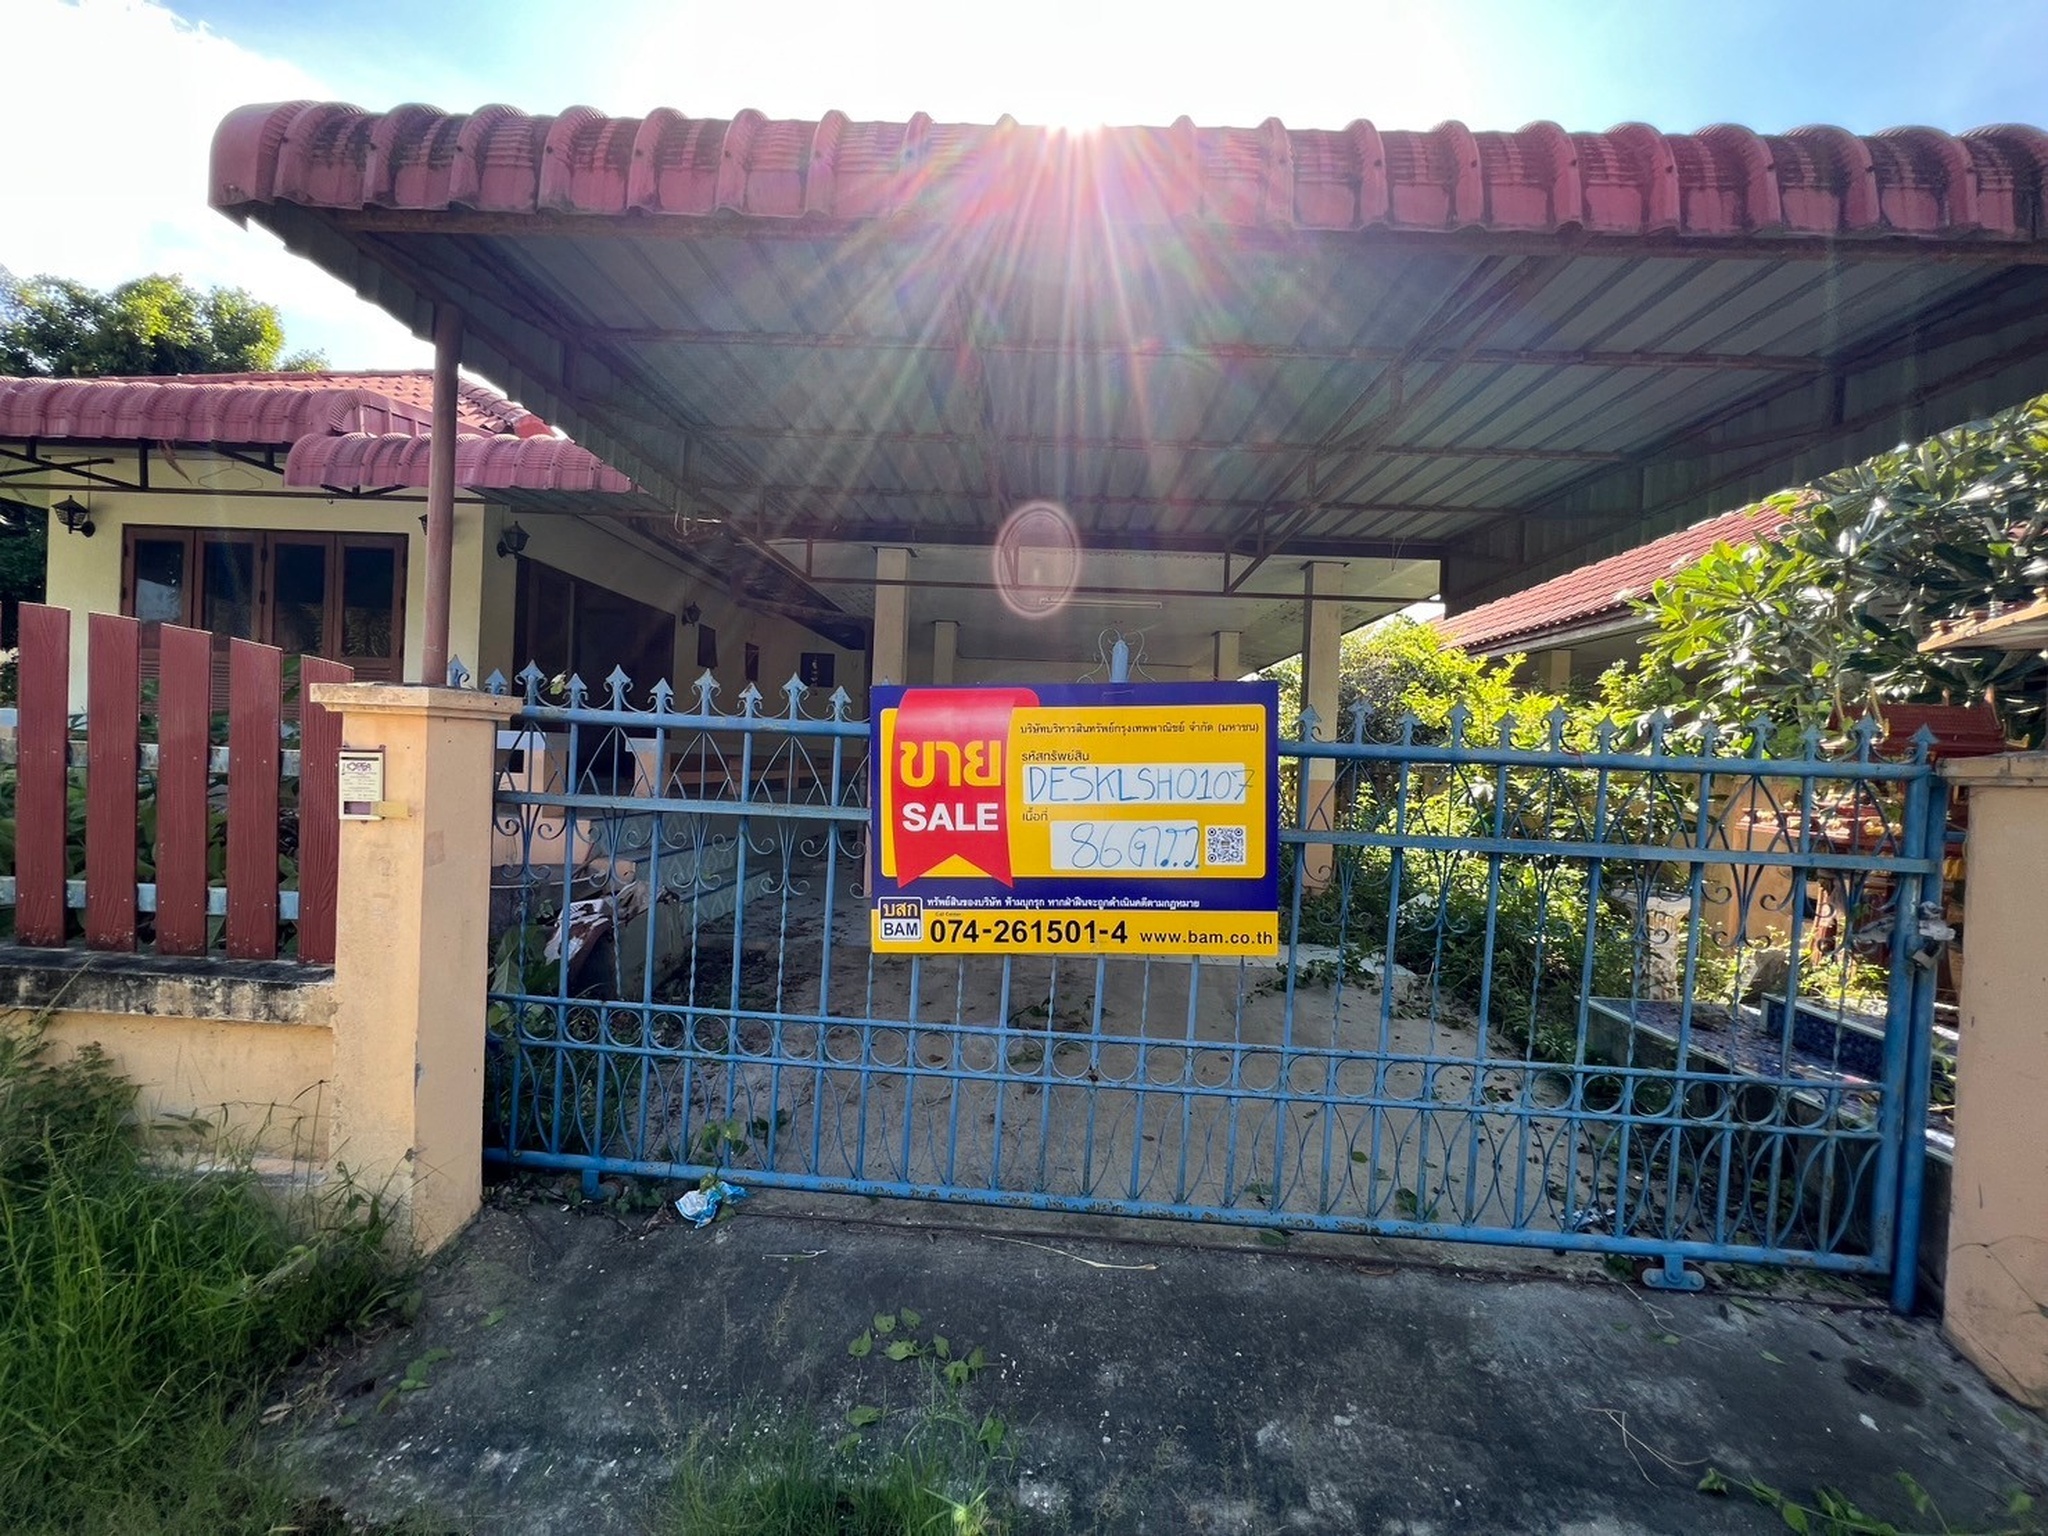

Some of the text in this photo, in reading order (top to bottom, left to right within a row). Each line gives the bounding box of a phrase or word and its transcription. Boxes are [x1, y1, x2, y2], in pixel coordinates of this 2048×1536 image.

[1190, 721, 1214, 732] จำกัด
[1218, 722, 1259, 733] (มหาชน)
[1021, 749, 1090, 762] รหัสทรัพย์สิน
[900, 740, 1002, 787] ขาย
[902, 802, 999, 832] SALE
[1022, 807, 1048, 822] เนื้อที่
[882, 902, 918, 917] บสก
[884, 922, 918, 936] BAM
[930, 919, 1128, 944] 074-261501-4
[1140, 930, 1273, 945] www.bam.co.th
